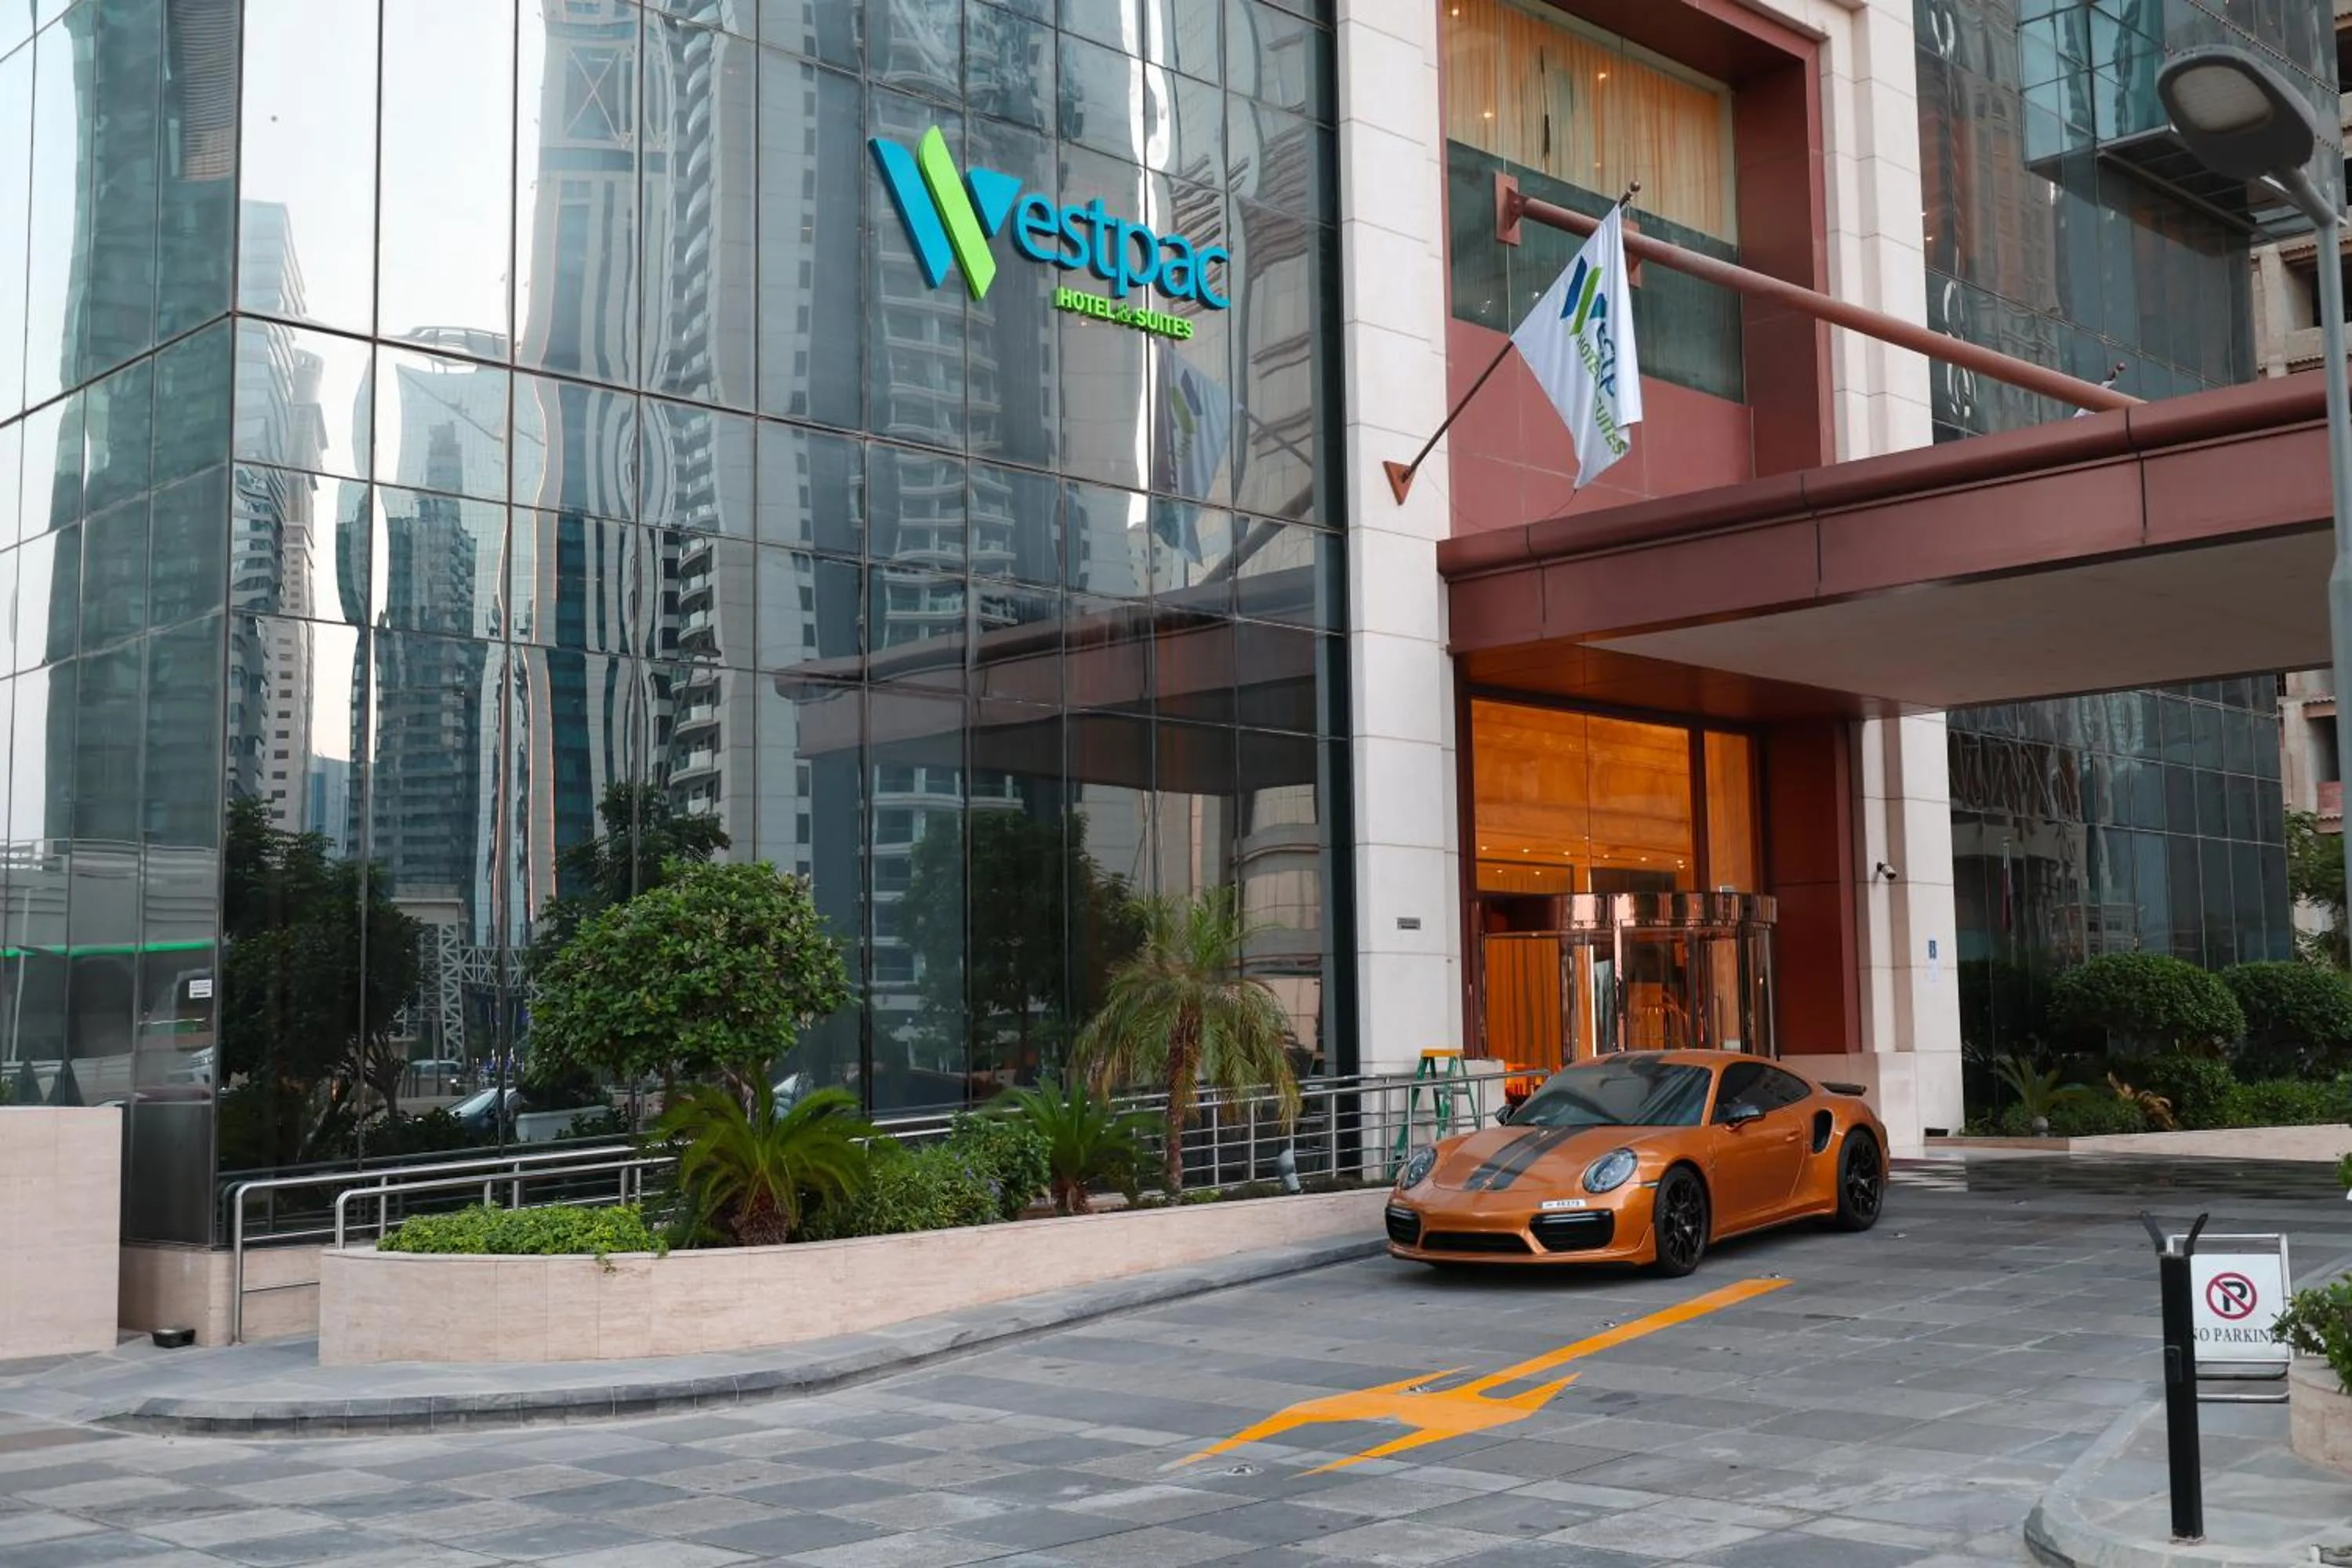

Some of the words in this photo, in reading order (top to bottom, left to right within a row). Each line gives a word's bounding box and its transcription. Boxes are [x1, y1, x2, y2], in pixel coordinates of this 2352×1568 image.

[1054, 286, 1115, 321] HOTEL
[1116, 302, 1132, 325] &
[1132, 307, 1194, 340] SUITES
